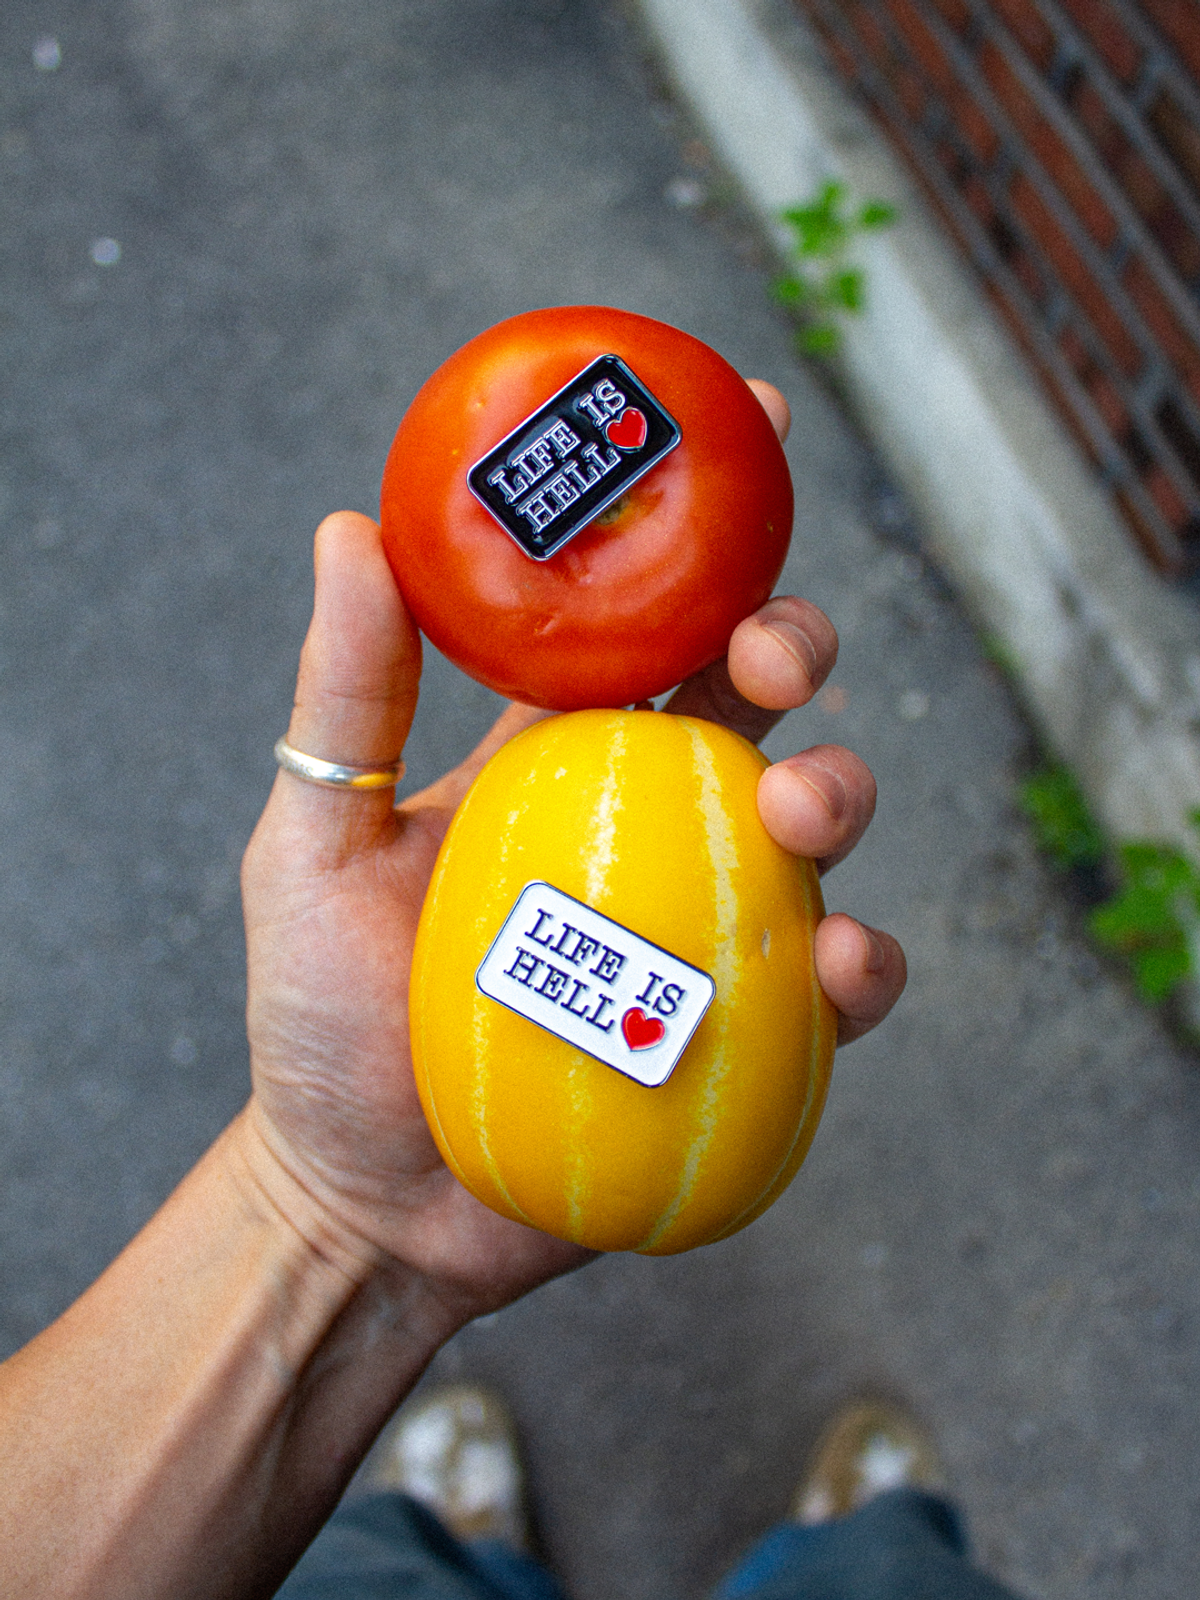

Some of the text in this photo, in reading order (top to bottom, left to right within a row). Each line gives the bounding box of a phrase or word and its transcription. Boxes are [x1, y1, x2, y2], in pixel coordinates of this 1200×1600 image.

[491, 379, 626, 503] LIFE IS
[517, 443, 622, 534] HELL
[503, 946, 615, 1033] HELL
[524, 908, 686, 1017] LIFE IS
